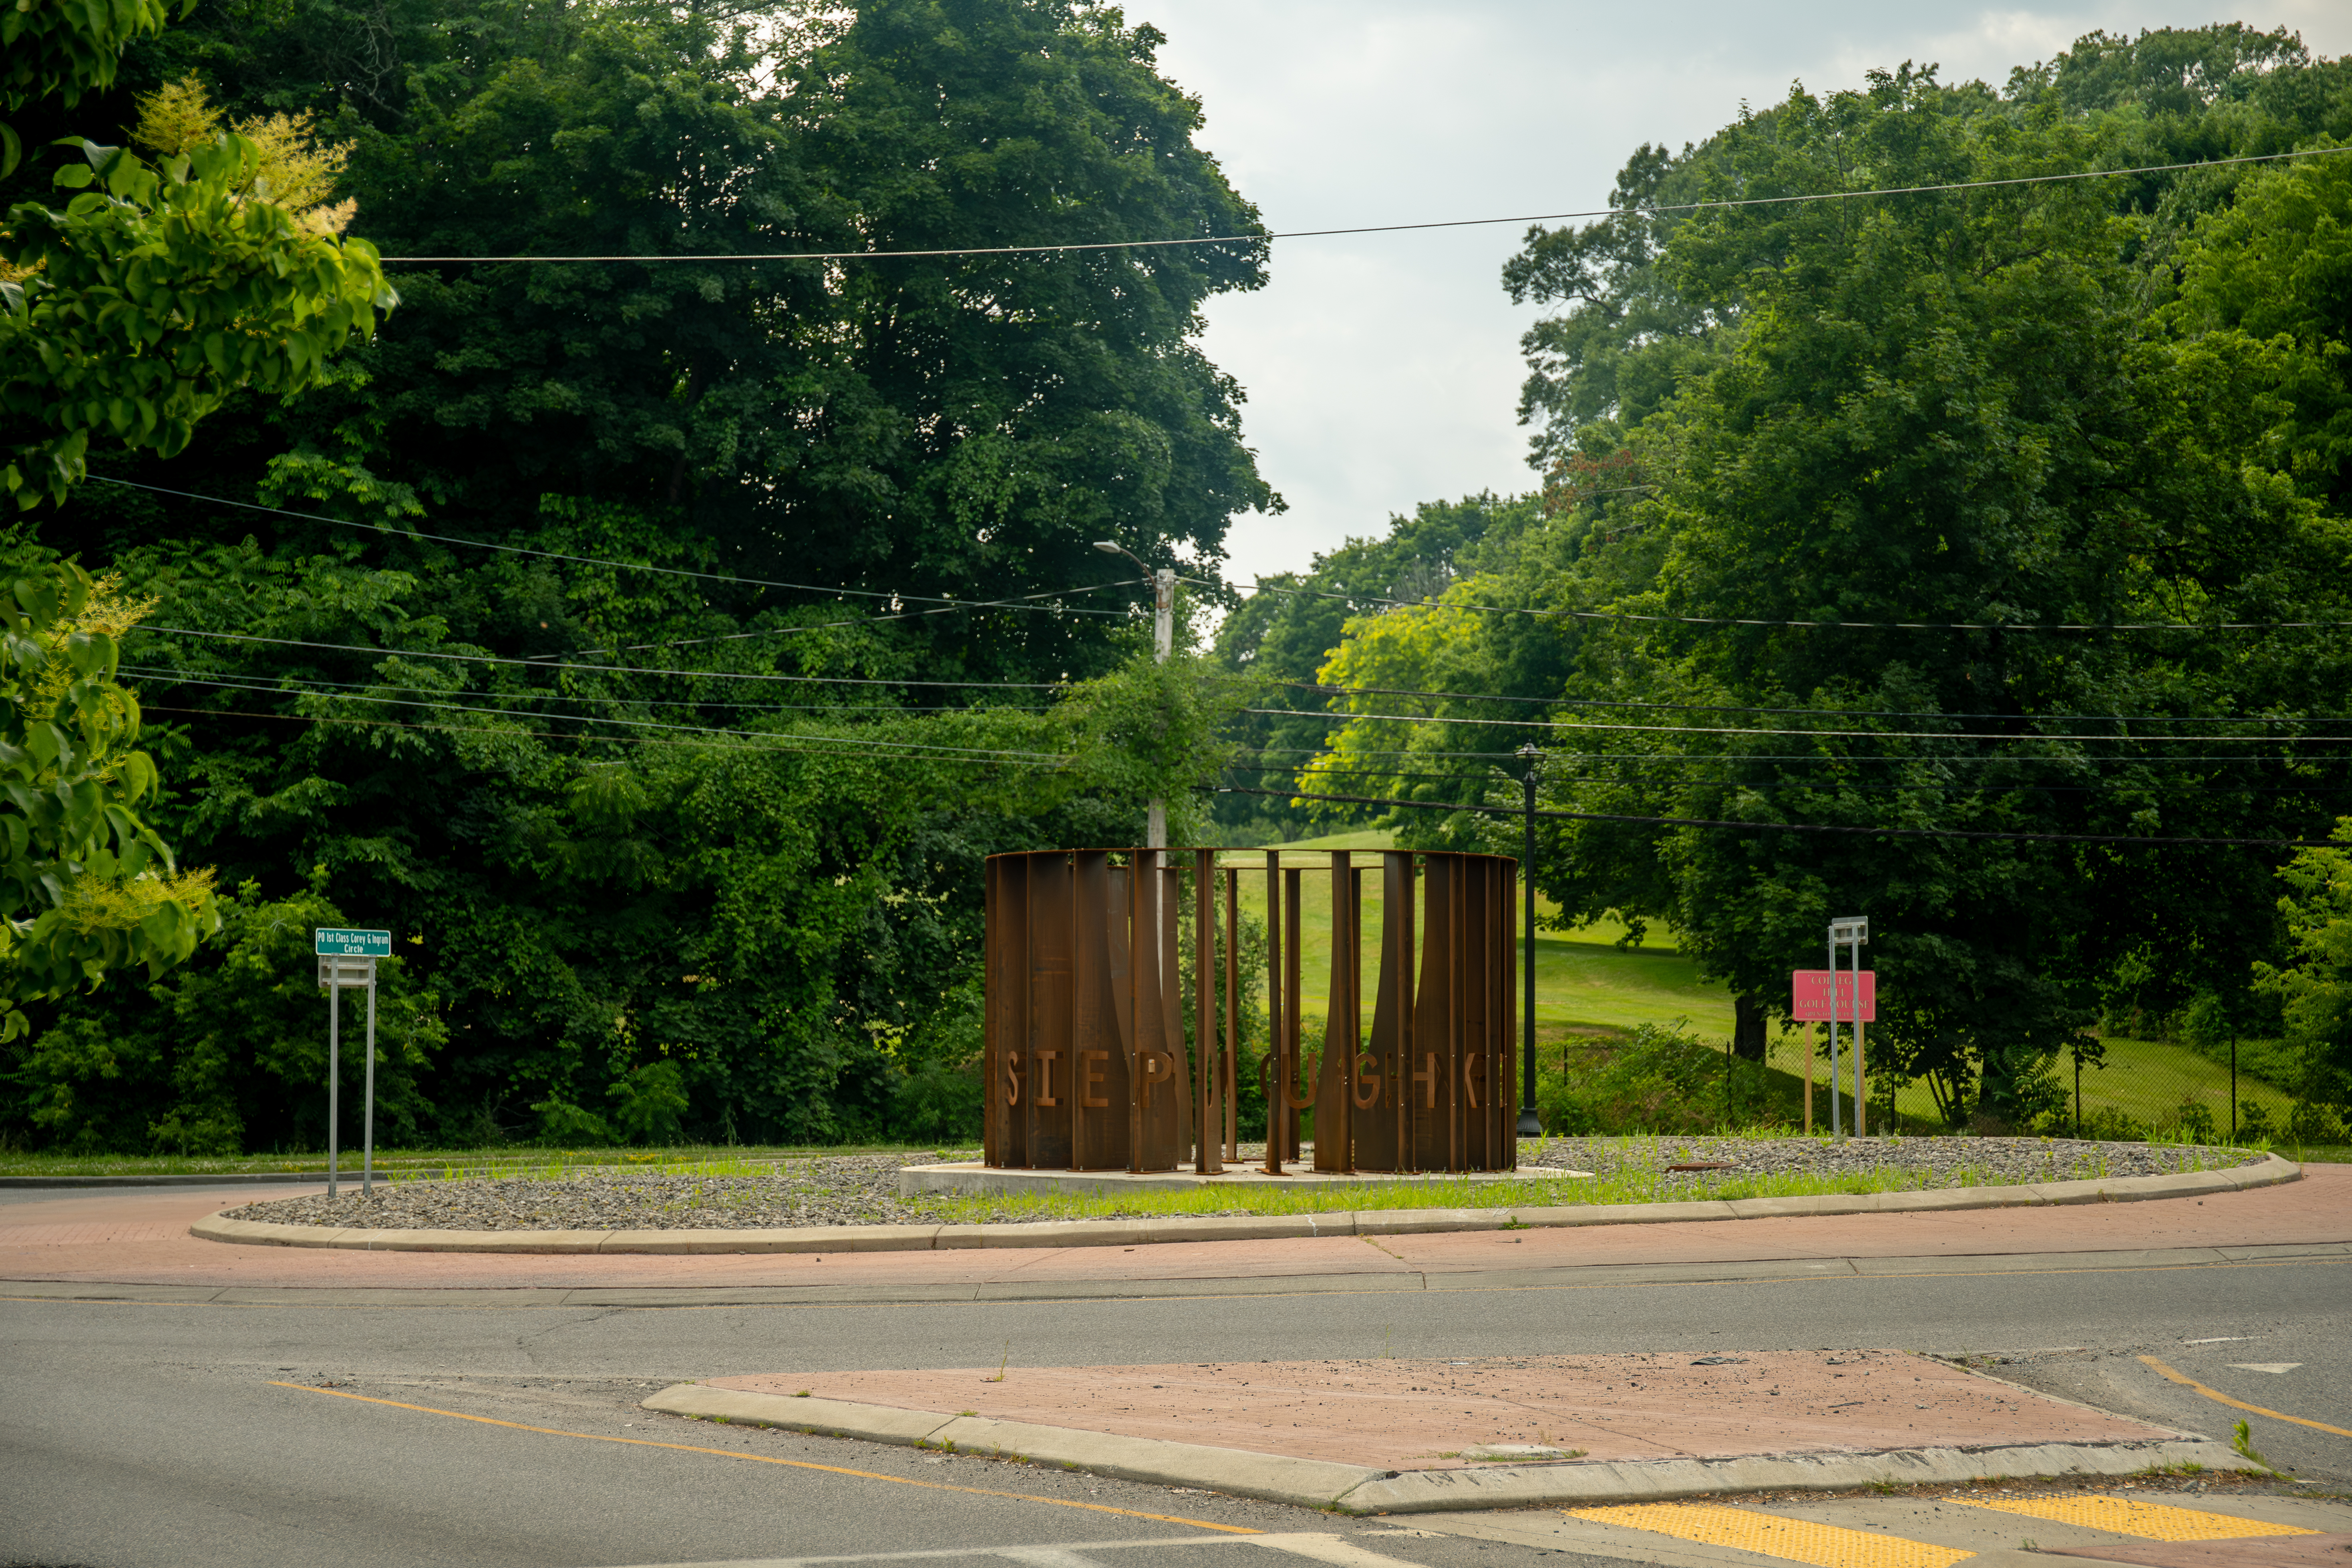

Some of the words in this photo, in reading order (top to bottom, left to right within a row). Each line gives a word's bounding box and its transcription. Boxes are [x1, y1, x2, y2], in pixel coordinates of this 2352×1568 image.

[318, 932, 325, 942] PO
[336, 932, 349, 943] Class
[351, 933, 365, 946] Corey
[372, 934, 388, 947] Ingram
[344, 944, 363, 953] Circle
[1799, 999, 1827, 1008] GOLF
